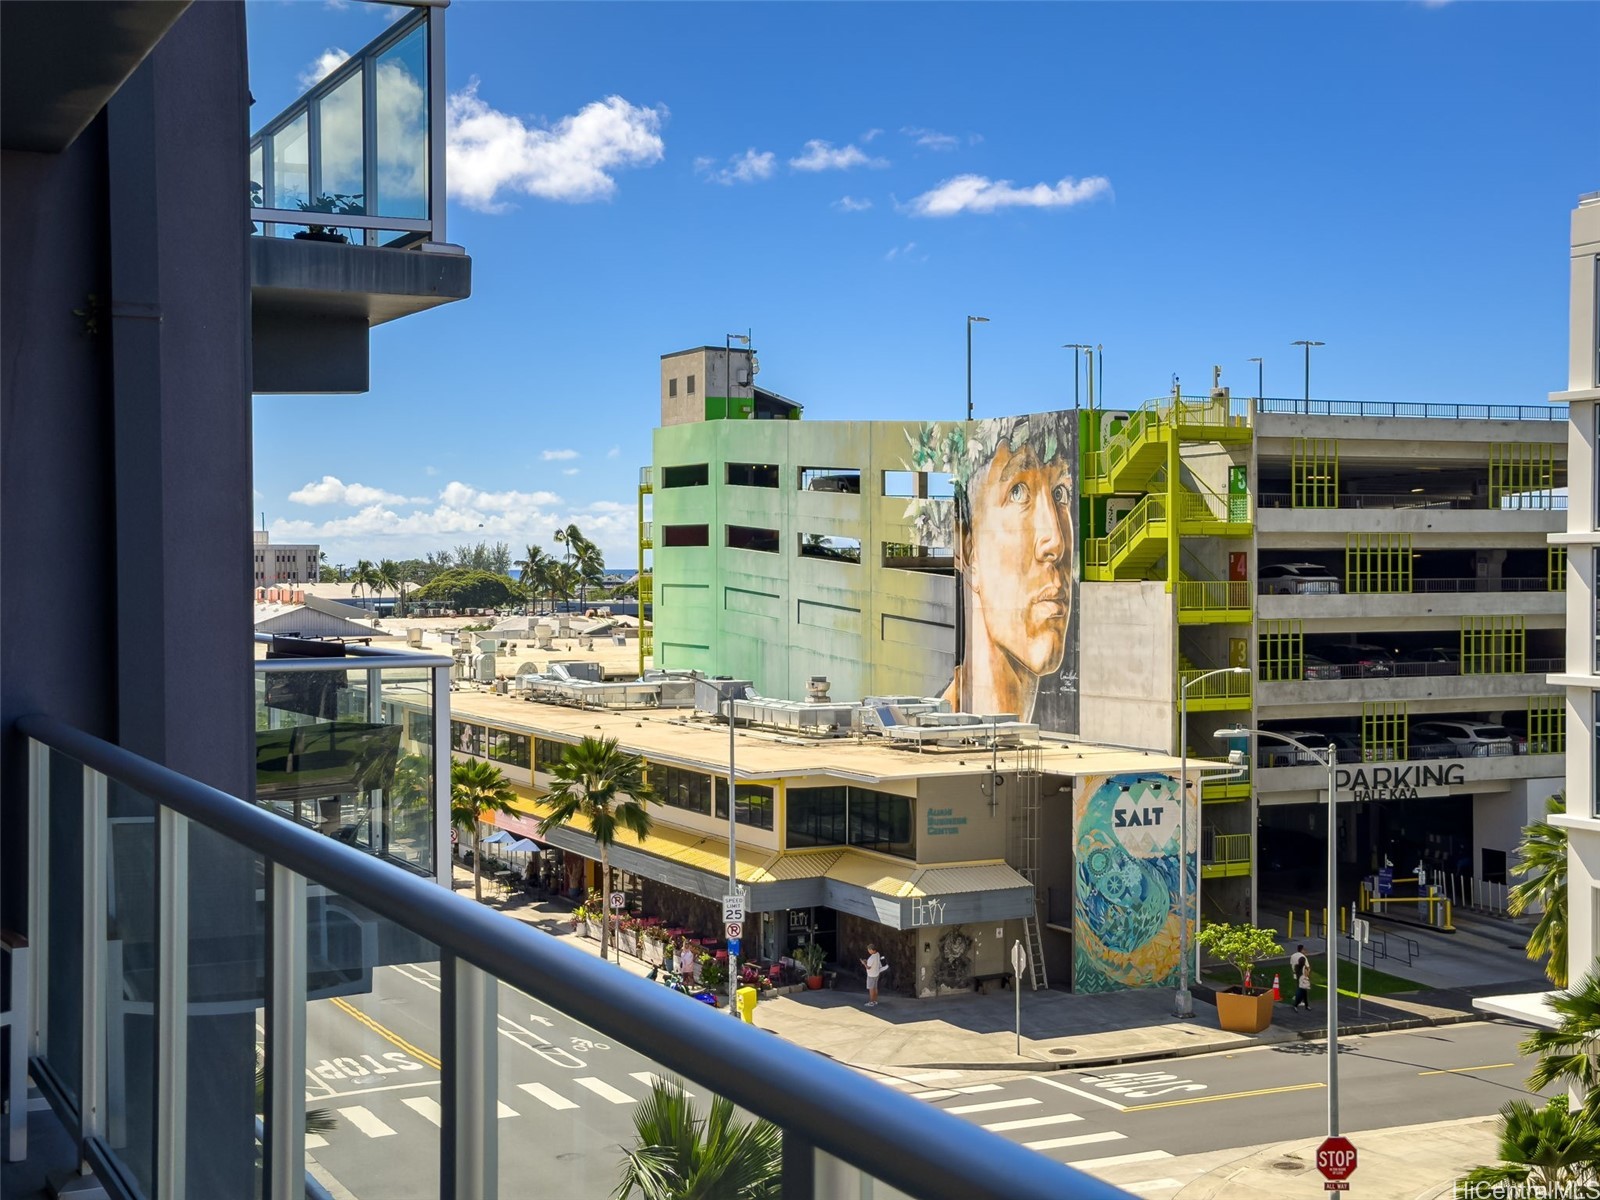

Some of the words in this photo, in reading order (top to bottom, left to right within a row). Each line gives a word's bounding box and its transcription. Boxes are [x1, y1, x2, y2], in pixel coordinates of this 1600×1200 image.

[1237, 554, 1246, 576] 4
[1238, 641, 1247, 663] 3
[1335, 763, 1465, 792] PARKING
[1354, 788, 1386, 802] HALE
[1114, 807, 1164, 828] SALT
[726, 910, 742, 920] 25
[314, 1052, 424, 1079] STOP
[1319, 1150, 1354, 1167] STOP
